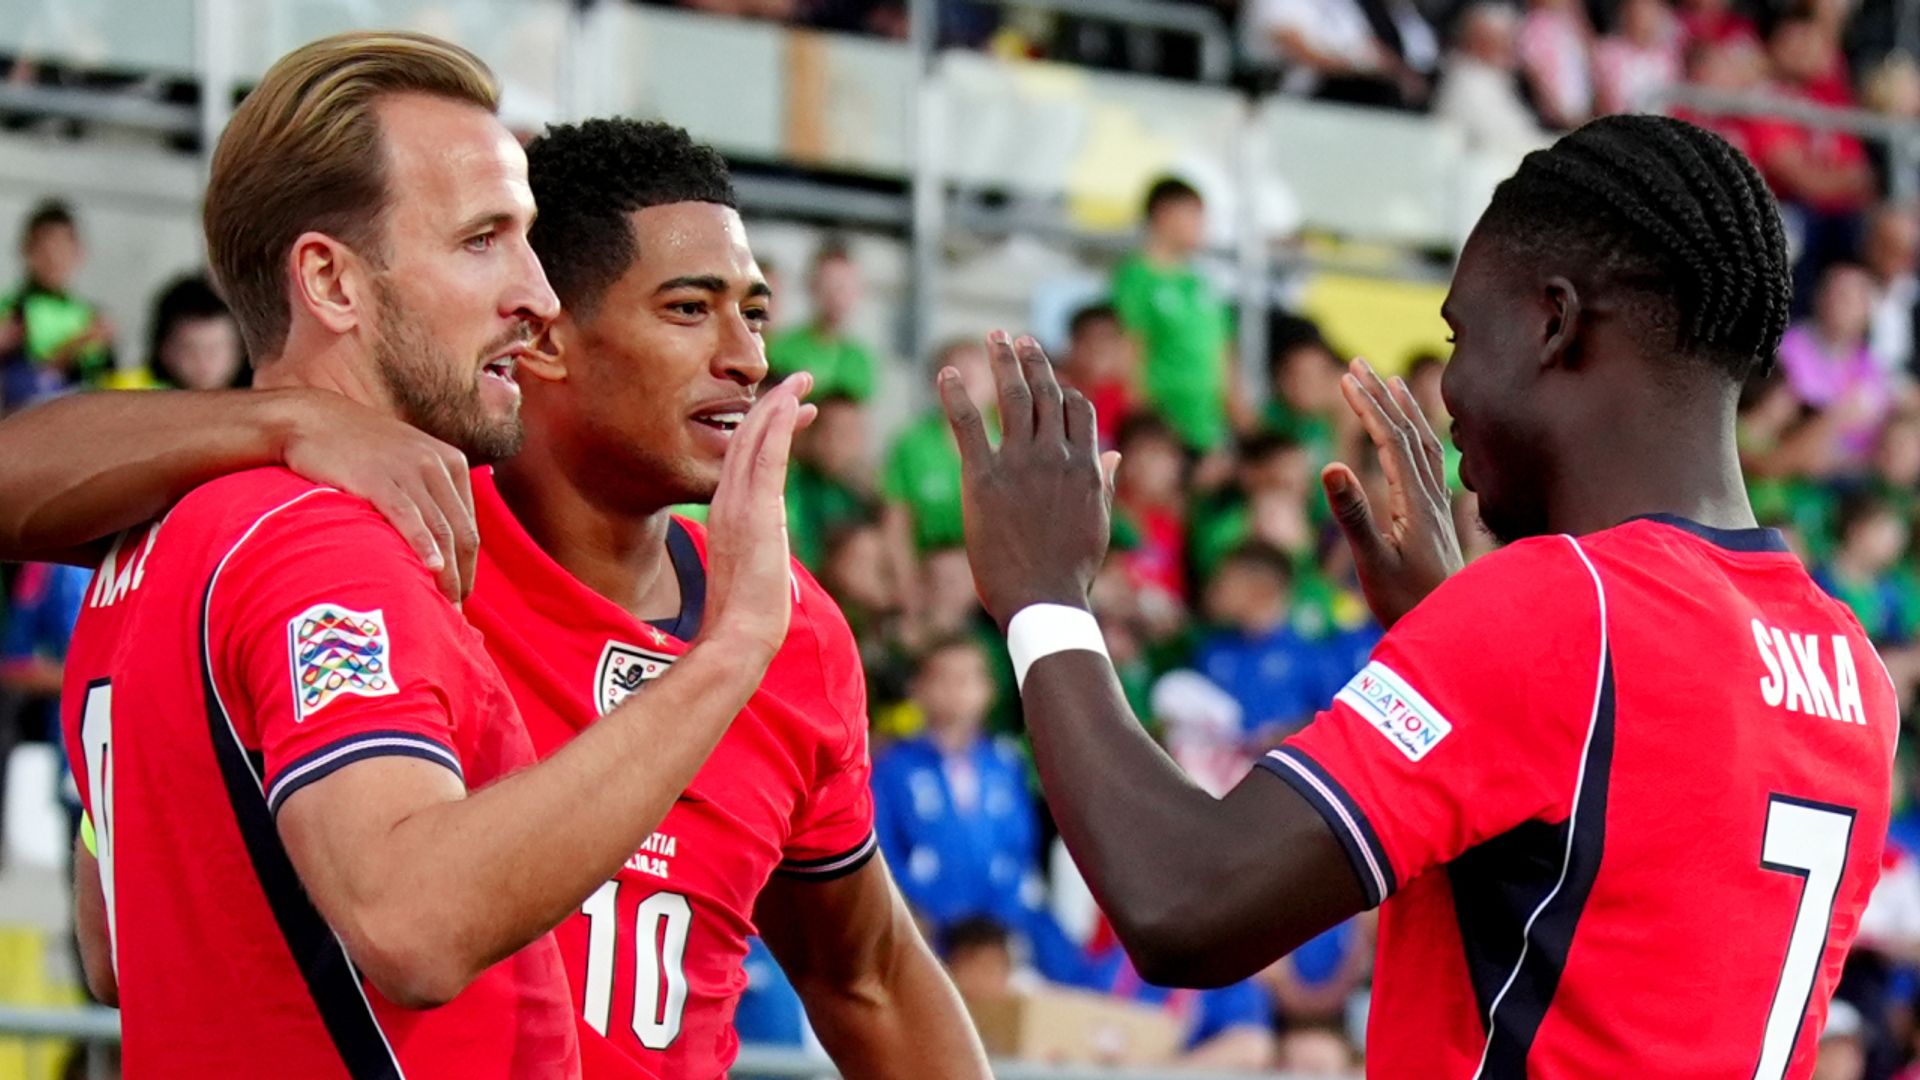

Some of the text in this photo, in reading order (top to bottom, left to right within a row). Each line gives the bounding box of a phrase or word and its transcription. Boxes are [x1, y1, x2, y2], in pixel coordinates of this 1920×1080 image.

[1750, 617, 1867, 725] SAKA
[640, 831, 677, 858] ATIA
[581, 879, 693, 1051] 10
[1752, 792, 1857, 1080] 7
